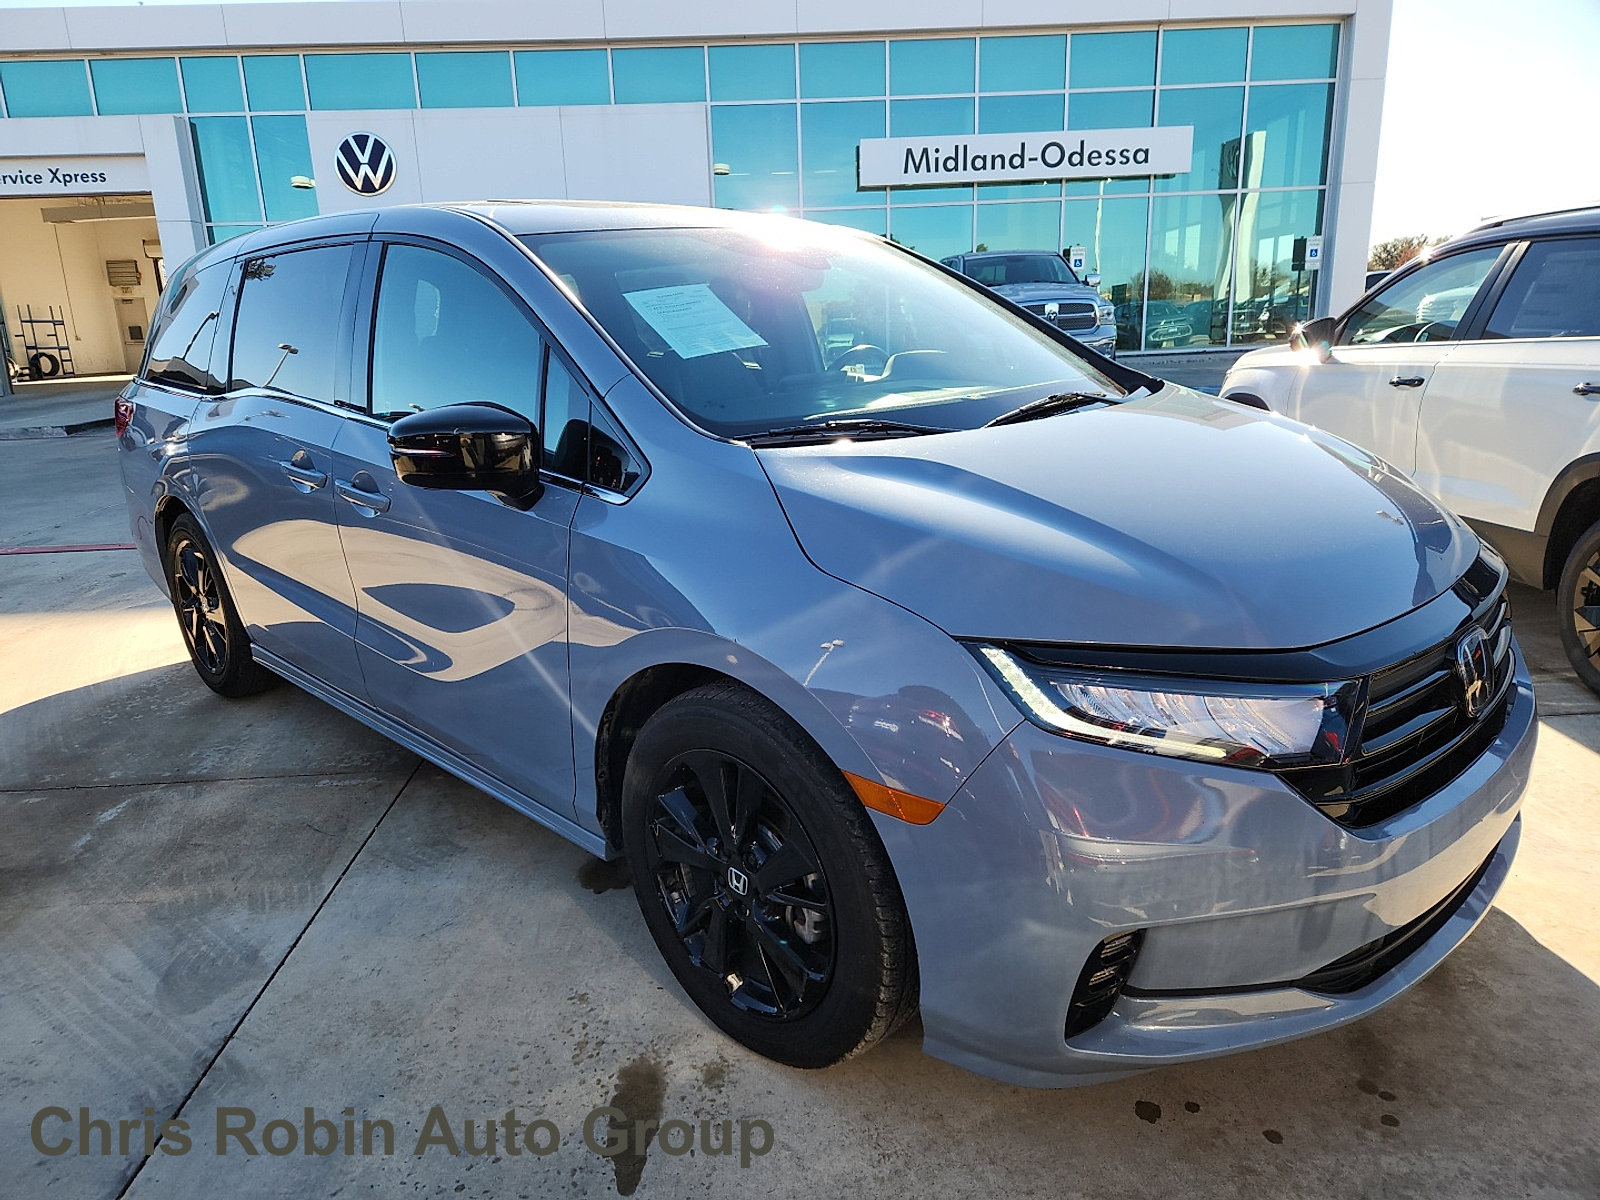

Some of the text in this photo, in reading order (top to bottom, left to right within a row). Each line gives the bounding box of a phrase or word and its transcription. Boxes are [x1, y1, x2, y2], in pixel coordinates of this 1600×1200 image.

[335, 131, 395, 193] VW
[902, 139, 1151, 175] Midland-Odessa
[0, 167, 107, 187] rvice Xpress
